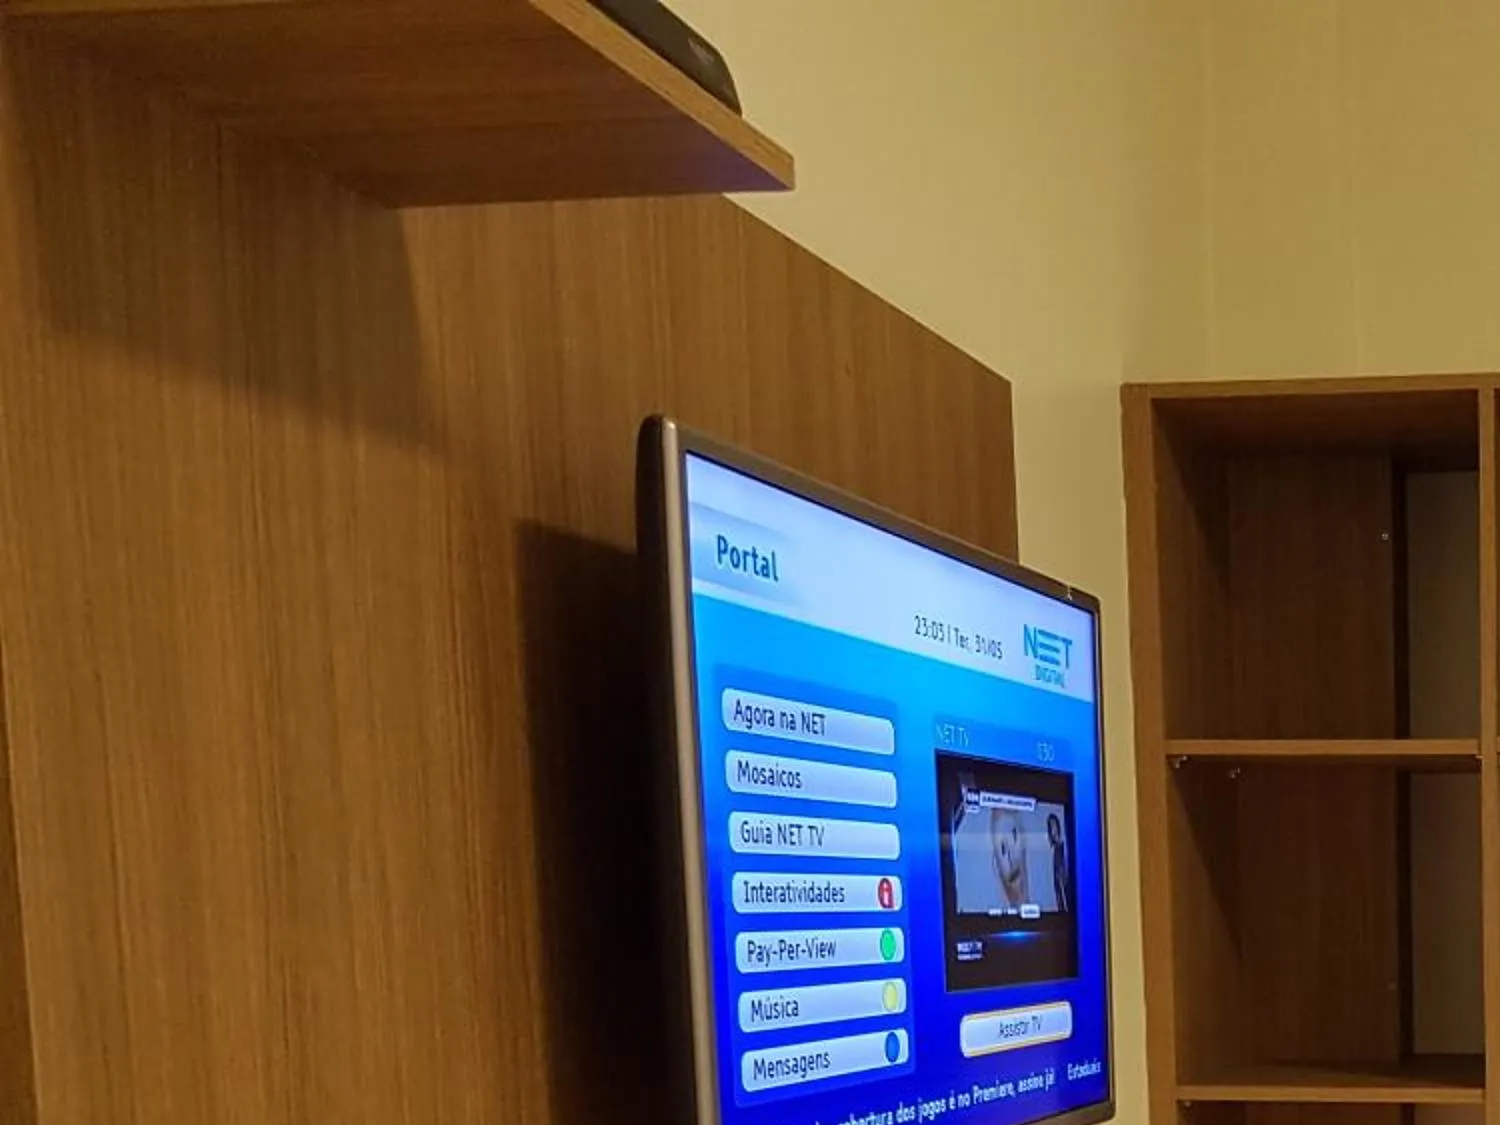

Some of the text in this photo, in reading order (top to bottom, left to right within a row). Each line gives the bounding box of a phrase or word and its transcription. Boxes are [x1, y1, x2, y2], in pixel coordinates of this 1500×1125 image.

[716, 535, 779, 583] Portal
[1023, 623, 1073, 669] NET
[1035, 664, 1066, 689] DIGITAL
[733, 698, 826, 736] Agora na NET
[737, 760, 802, 789] Mosaicos
[740, 820, 825, 847] Guia NET TV
[743, 880, 845, 903] Interatividades
[747, 937, 837, 967] Pay-Per-View
[751, 995, 799, 1022] Música
[753, 1052, 831, 1080] Mensagens
[896, 1102, 915, 1122] dos
[918, 1097, 946, 1124] jogos
[958, 1092, 970, 1107] no
[1018, 1072, 1043, 1093] assine
